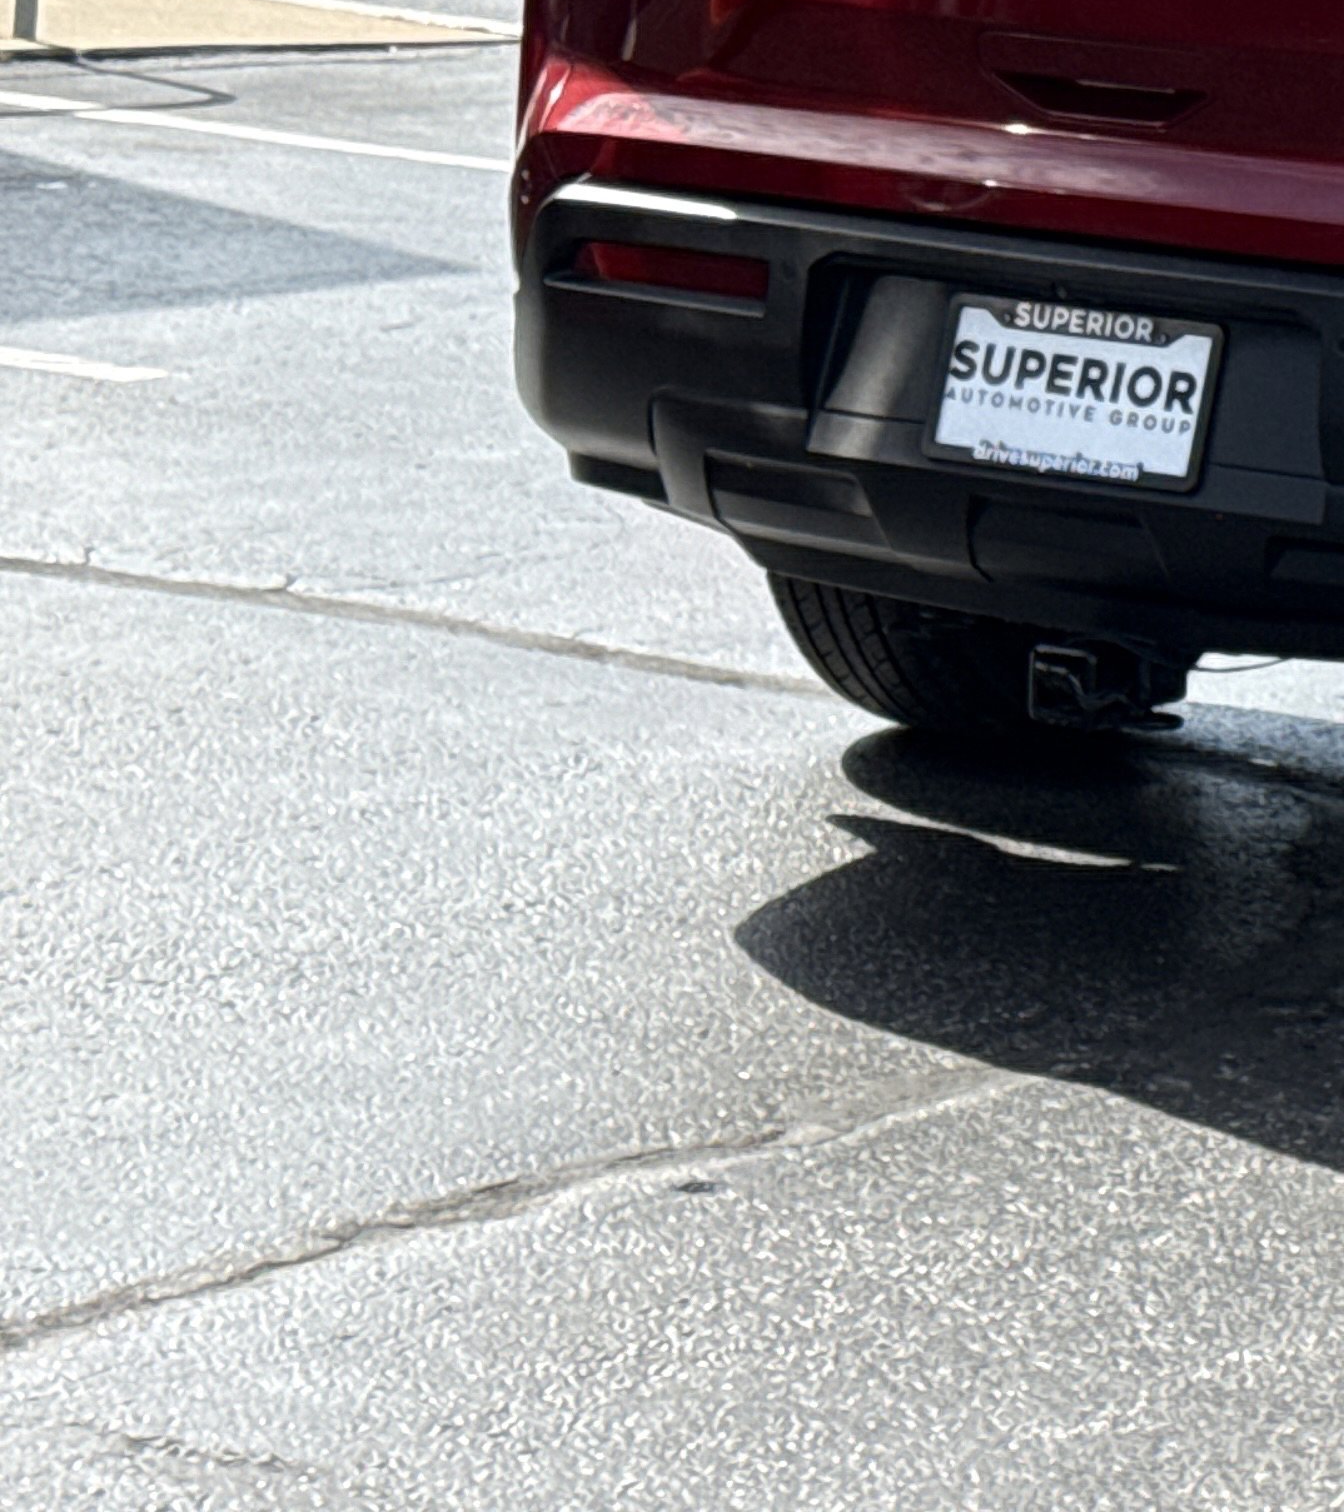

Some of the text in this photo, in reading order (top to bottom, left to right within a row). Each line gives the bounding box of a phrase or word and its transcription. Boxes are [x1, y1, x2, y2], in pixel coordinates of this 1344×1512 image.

[1014, 302, 1154, 341] SUPERIOR
[949, 339, 1198, 415] SUPERIOR
[944, 386, 1191, 435] AUTOMOTIVE GROUP
[973, 441, 1139, 481] drivesuperior.com
